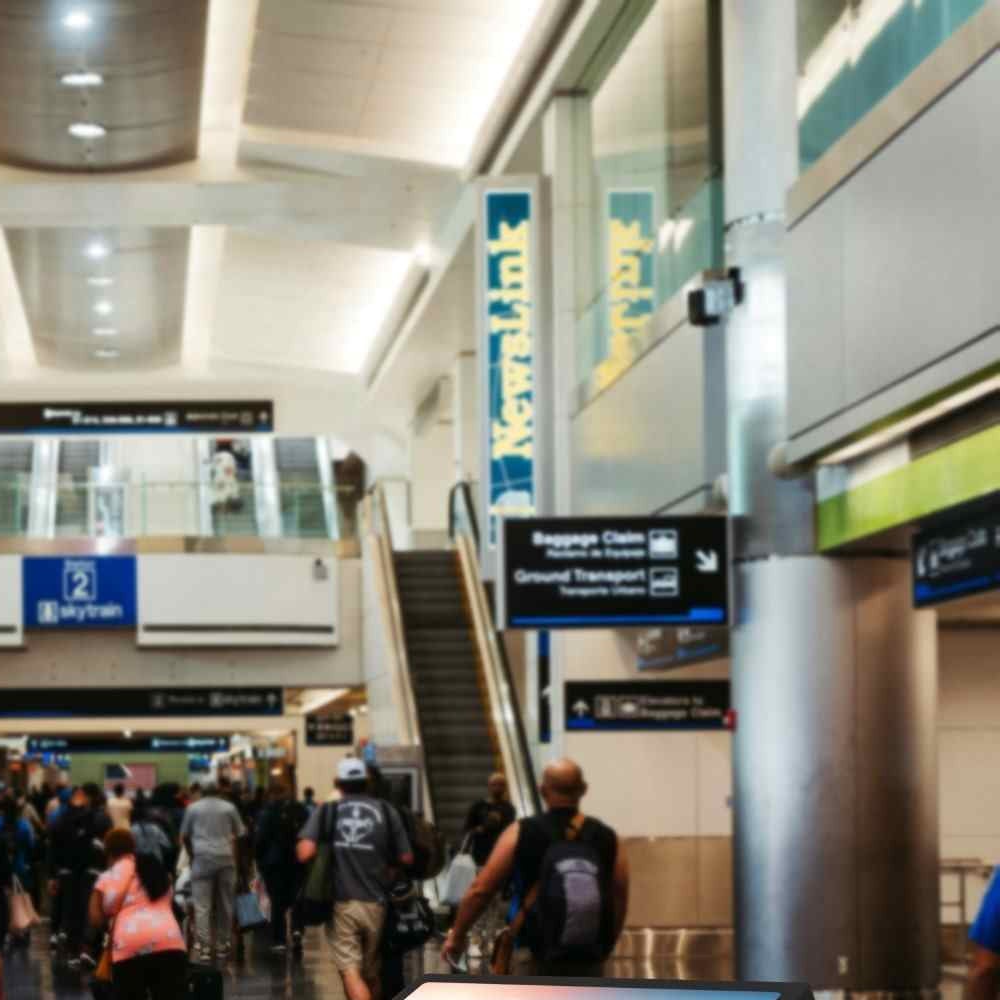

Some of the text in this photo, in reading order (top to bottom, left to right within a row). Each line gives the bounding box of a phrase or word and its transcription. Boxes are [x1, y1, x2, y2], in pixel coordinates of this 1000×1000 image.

[487, 219, 533, 461] NewsLink
[532, 529, 647, 548] Baggage Claim
[72, 571, 90, 598] 2
[514, 566, 647, 585] Ground Transport
